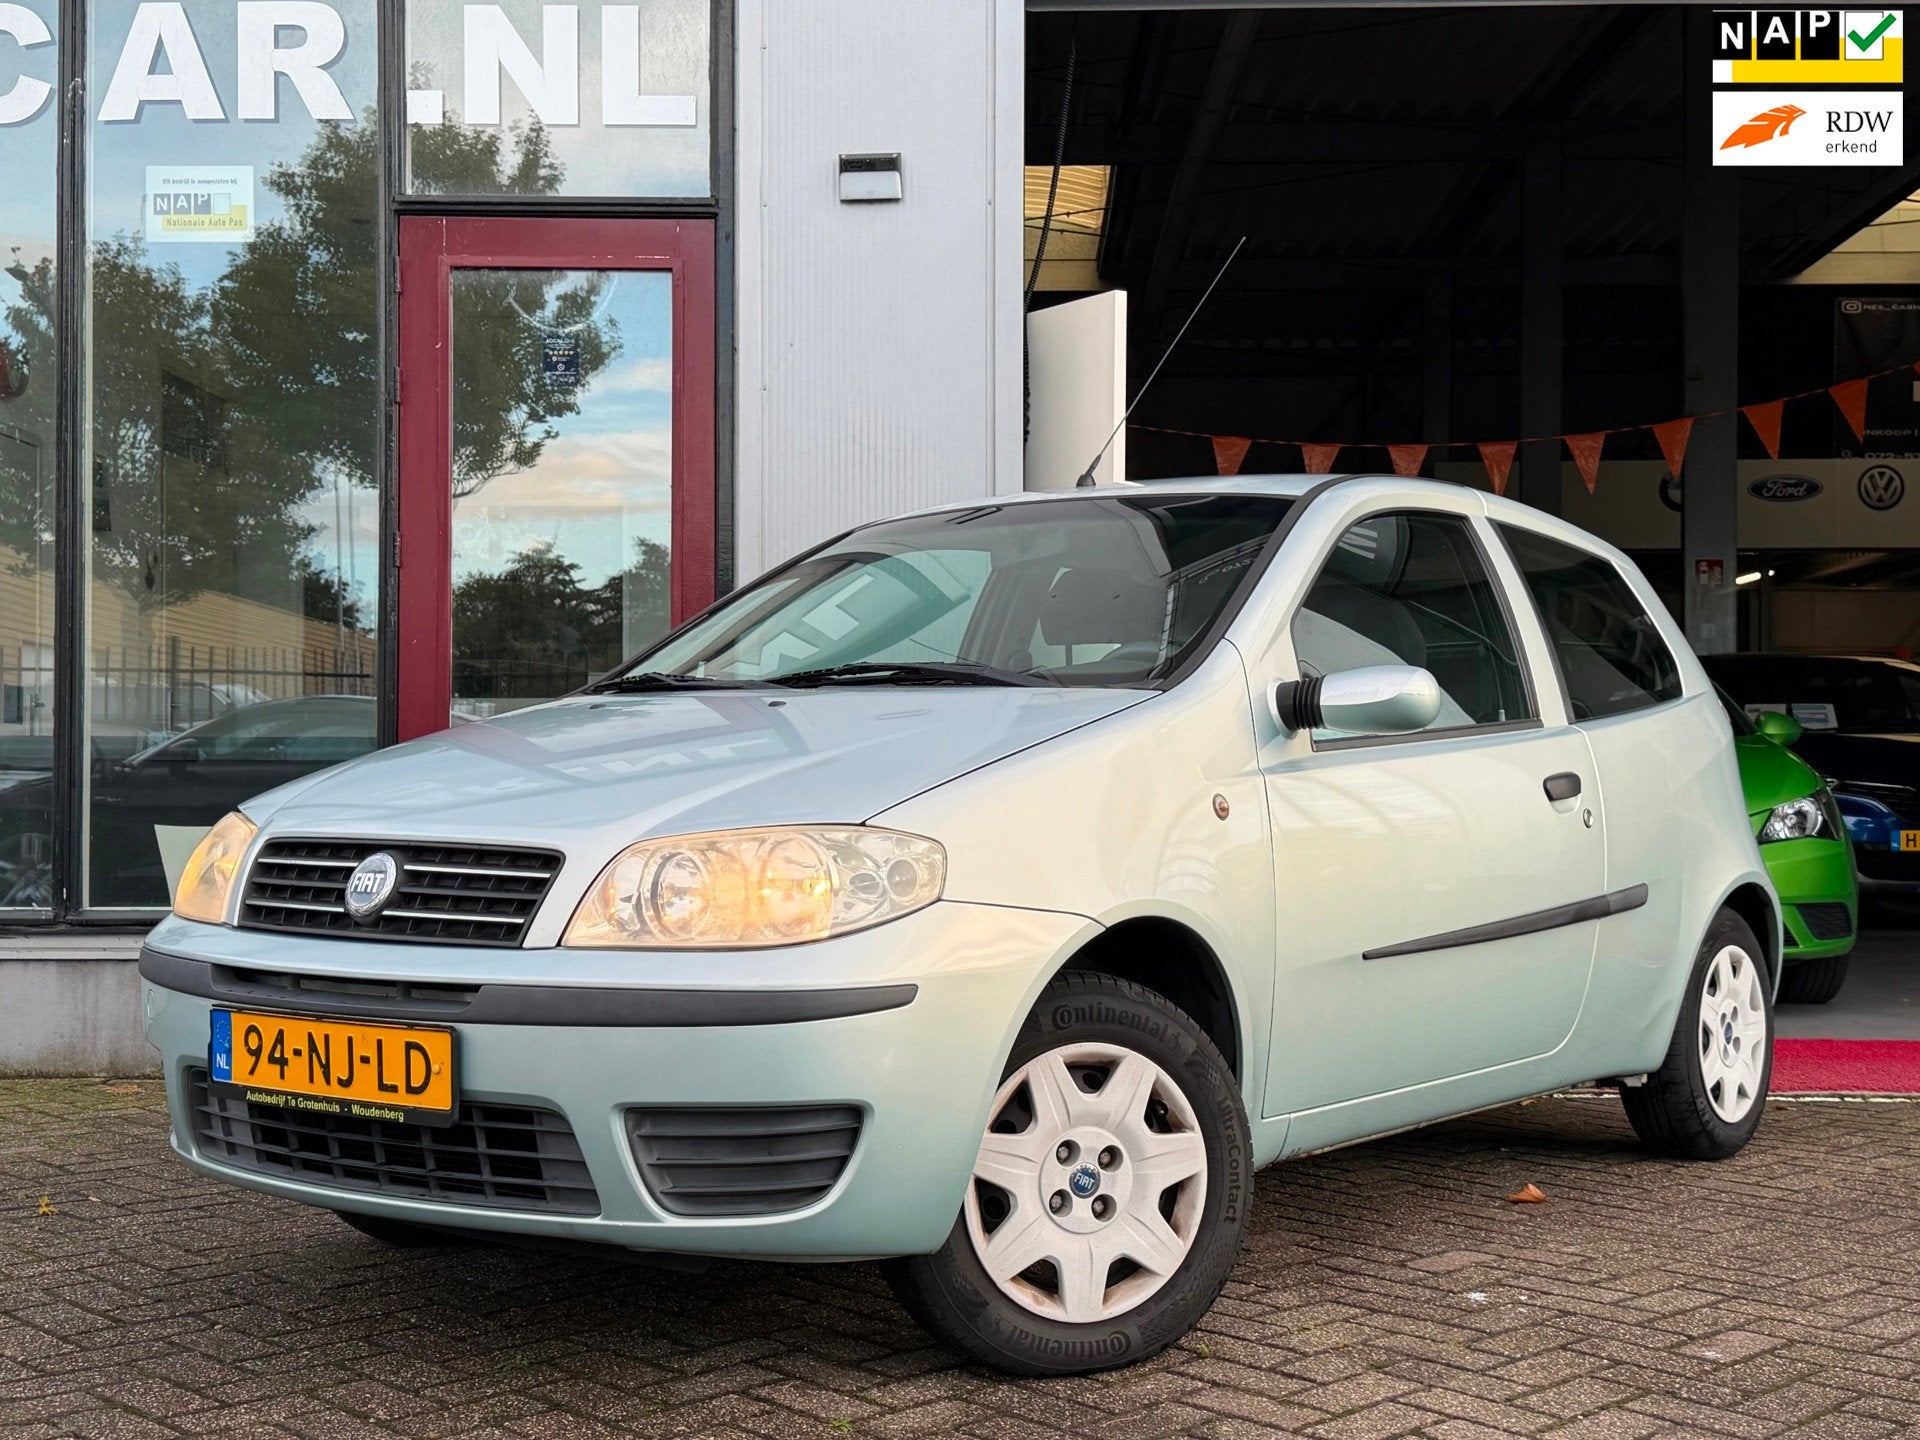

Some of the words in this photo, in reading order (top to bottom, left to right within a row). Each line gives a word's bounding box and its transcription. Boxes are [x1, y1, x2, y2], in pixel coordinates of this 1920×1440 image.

[156, 193, 208, 211] NAP
[166, 218, 205, 227] Nationale
[208, 218, 226, 227] Auto
[229, 218, 243, 227] Pas
[1863, 429, 1912, 437] NKOOP
[1762, 478, 1808, 499] Ford
[351, 872, 386, 893] FIAT
[1051, 1003, 1170, 1044] Continental
[216, 1052, 230, 1070] NL
[243, 1023, 432, 1095] 94-NJ-LD
[246, 1090, 286, 1108] Autobedrijf
[287, 1096, 297, 1107] Te
[297, 1097, 341, 1113] Grotenhuis
[351, 1104, 405, 1123] Woudenberg
[1216, 1097, 1242, 1225] UltraContact
[1073, 1171, 1095, 1190] FIAT
[1010, 1325, 1132, 1365] Continental
